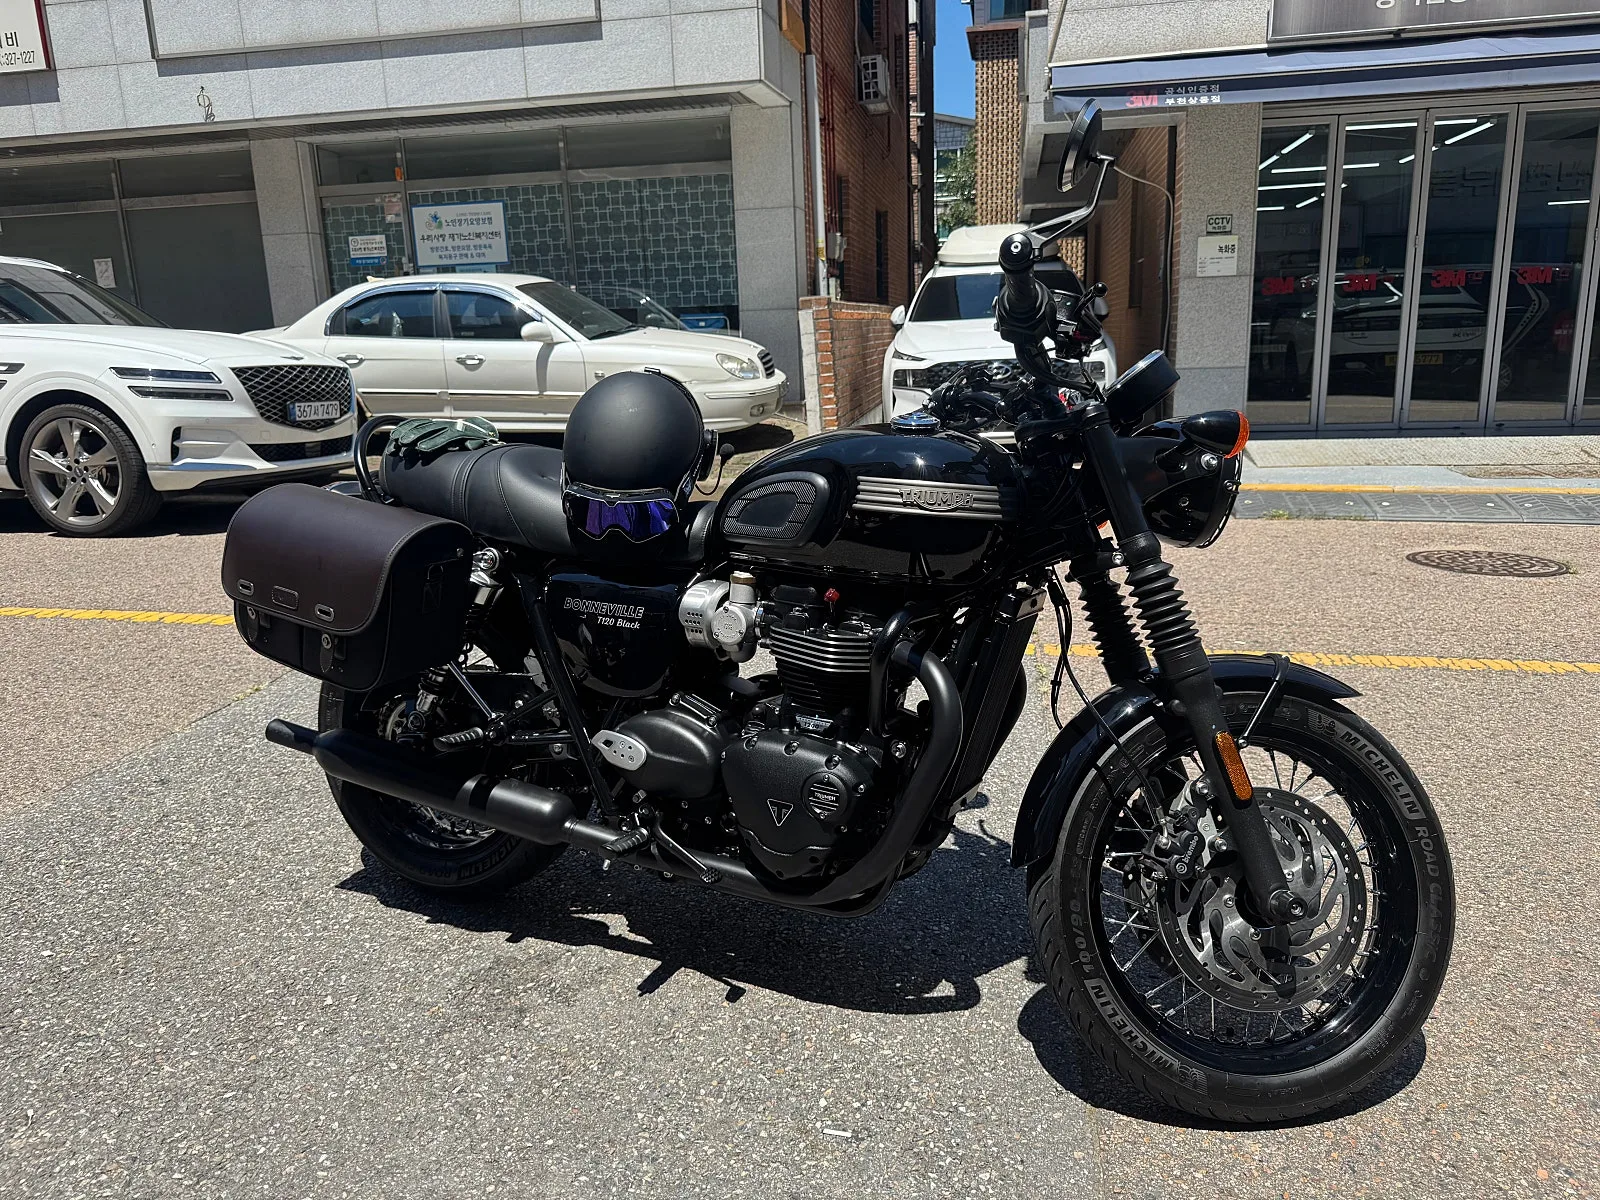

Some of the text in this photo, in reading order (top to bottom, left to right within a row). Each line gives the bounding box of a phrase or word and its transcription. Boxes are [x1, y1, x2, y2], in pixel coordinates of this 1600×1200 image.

[0, 31, 19, 48] 비
[1125, 90, 1158, 107] 3M
[1164, 84, 1220, 96] 공식인증점
[1164, 95, 1221, 106] 부천상동점
[444, 216, 493, 228] 노인장기요양보험
[1208, 216, 1231, 226] CCTV
[1218, 244, 1236, 254] 녹화중
[1342, 273, 1377, 293] 3M
[1431, 269, 1466, 288] 3M
[1516, 266, 1553, 285] 3M
[1261, 276, 1294, 296] 3M
[320, 403, 338, 417] 7479
[900, 488, 974, 511] TRIUMPH
[563, 597, 645, 619] BONNEVILLE
[597, 616, 641, 629] T120 Black
[1340, 730, 1420, 815] MICHELIN
[814, 791, 836, 801] TRIUMPH
[1182, 835, 1199, 864] brembo
[1414, 825, 1443, 963] ROAD CLASSIC
[1090, 984, 1176, 1071] MICHELIN
